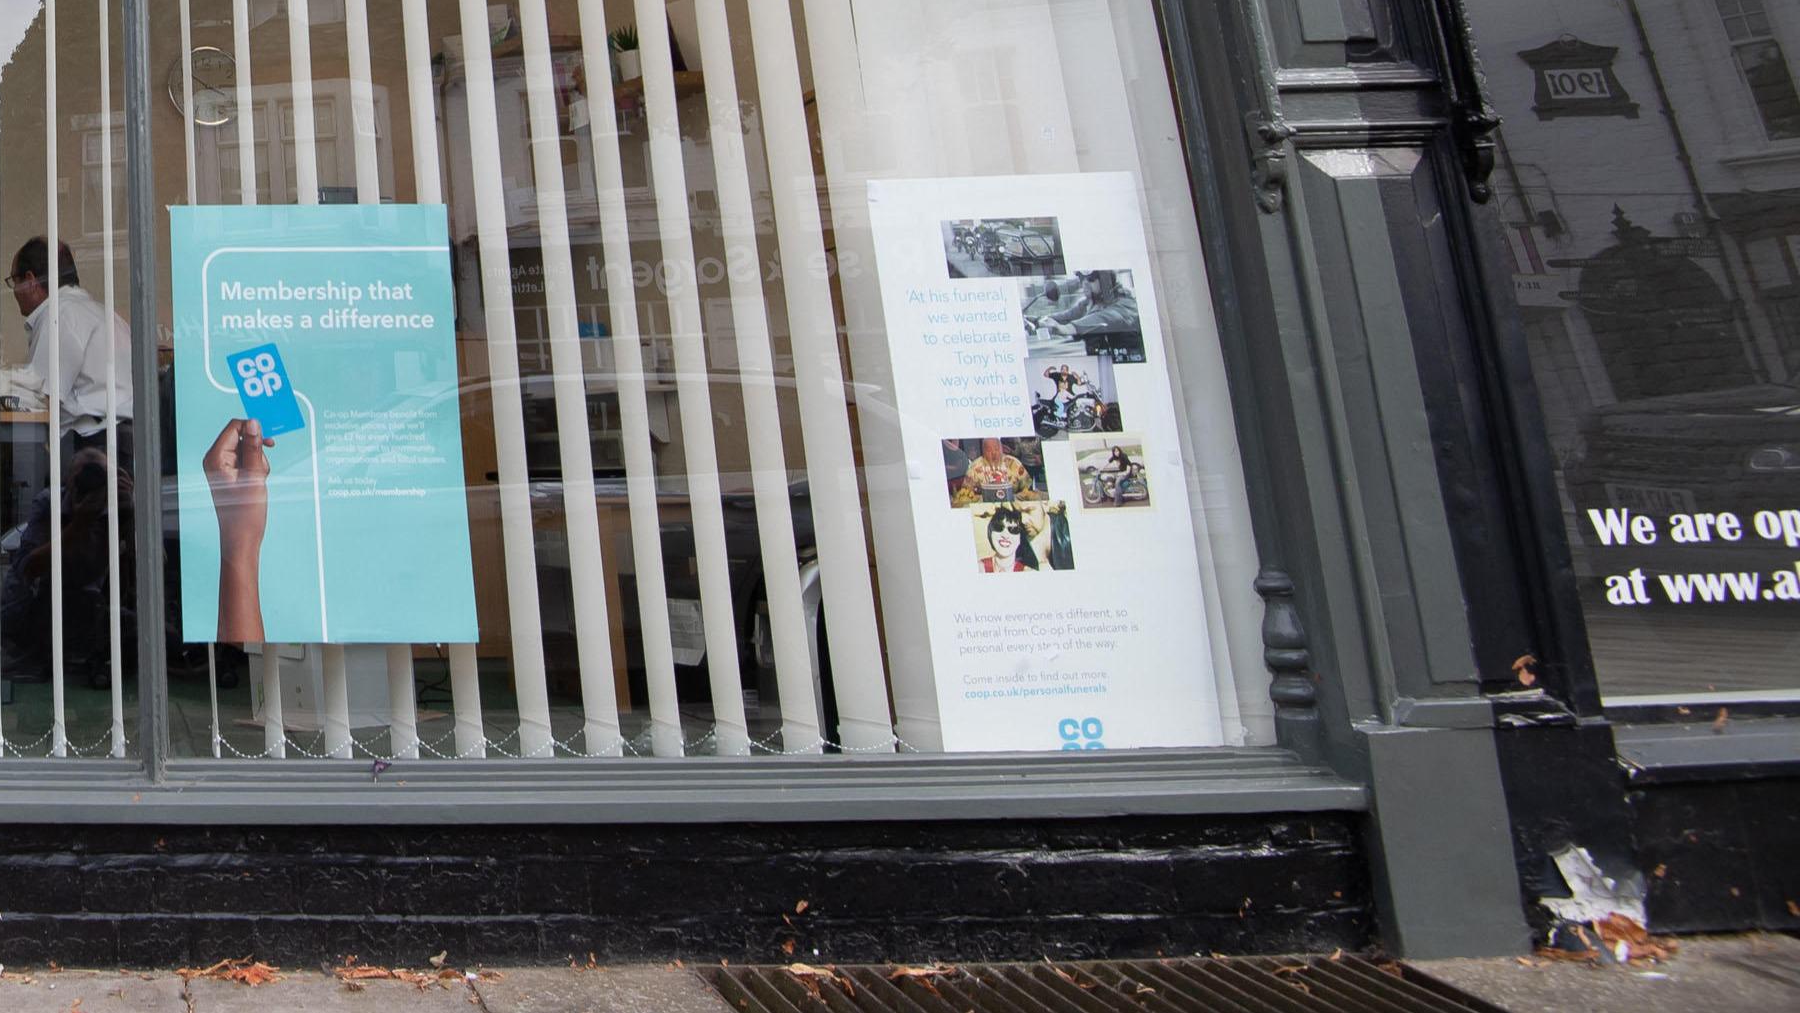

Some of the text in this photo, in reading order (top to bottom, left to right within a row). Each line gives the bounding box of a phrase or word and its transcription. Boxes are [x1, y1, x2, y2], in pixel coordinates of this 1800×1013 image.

[220, 280, 413, 305] Membership that
[929, 289, 949, 302] his
[952, 288, 1007, 302] funeral,
[221, 309, 434, 329] makes a difference
[928, 309, 1007, 324] we wanted
[924, 329, 1011, 345] to celebrate
[954, 351, 1015, 367] Tony his
[941, 372, 1017, 389] way with a
[946, 392, 1021, 407] motorbike
[1587, 508, 1657, 545] We
[1669, 512, 1742, 543] are
[1605, 568, 1651, 605] at
[954, 613, 971, 623] We
[975, 612, 1001, 623] know
[1005, 612, 1053, 623] everyone
[1056, 612, 1063, 621] is
[1066, 608, 1112, 620] different,
[957, 630, 963, 639] a
[966, 627, 1001, 638] funeral
[1004, 626, 1028, 637] from
[1067, 624, 1127, 635] Funeralcare
[1131, 624, 1139, 632] is
[959, 643, 1004, 657] personal
[1007, 643, 1034, 654] every
[1063, 640, 1073, 650] of
[1075, 640, 1093, 649] the
[963, 674, 992, 685] Come
[996, 674, 1024, 683] inside
[1028, 673, 1037, 682] to
[1040, 671, 1059, 681] find
[1062, 672, 1078, 680] out
[965, 683, 1107, 700] coop.co.uk/personalfunerals
